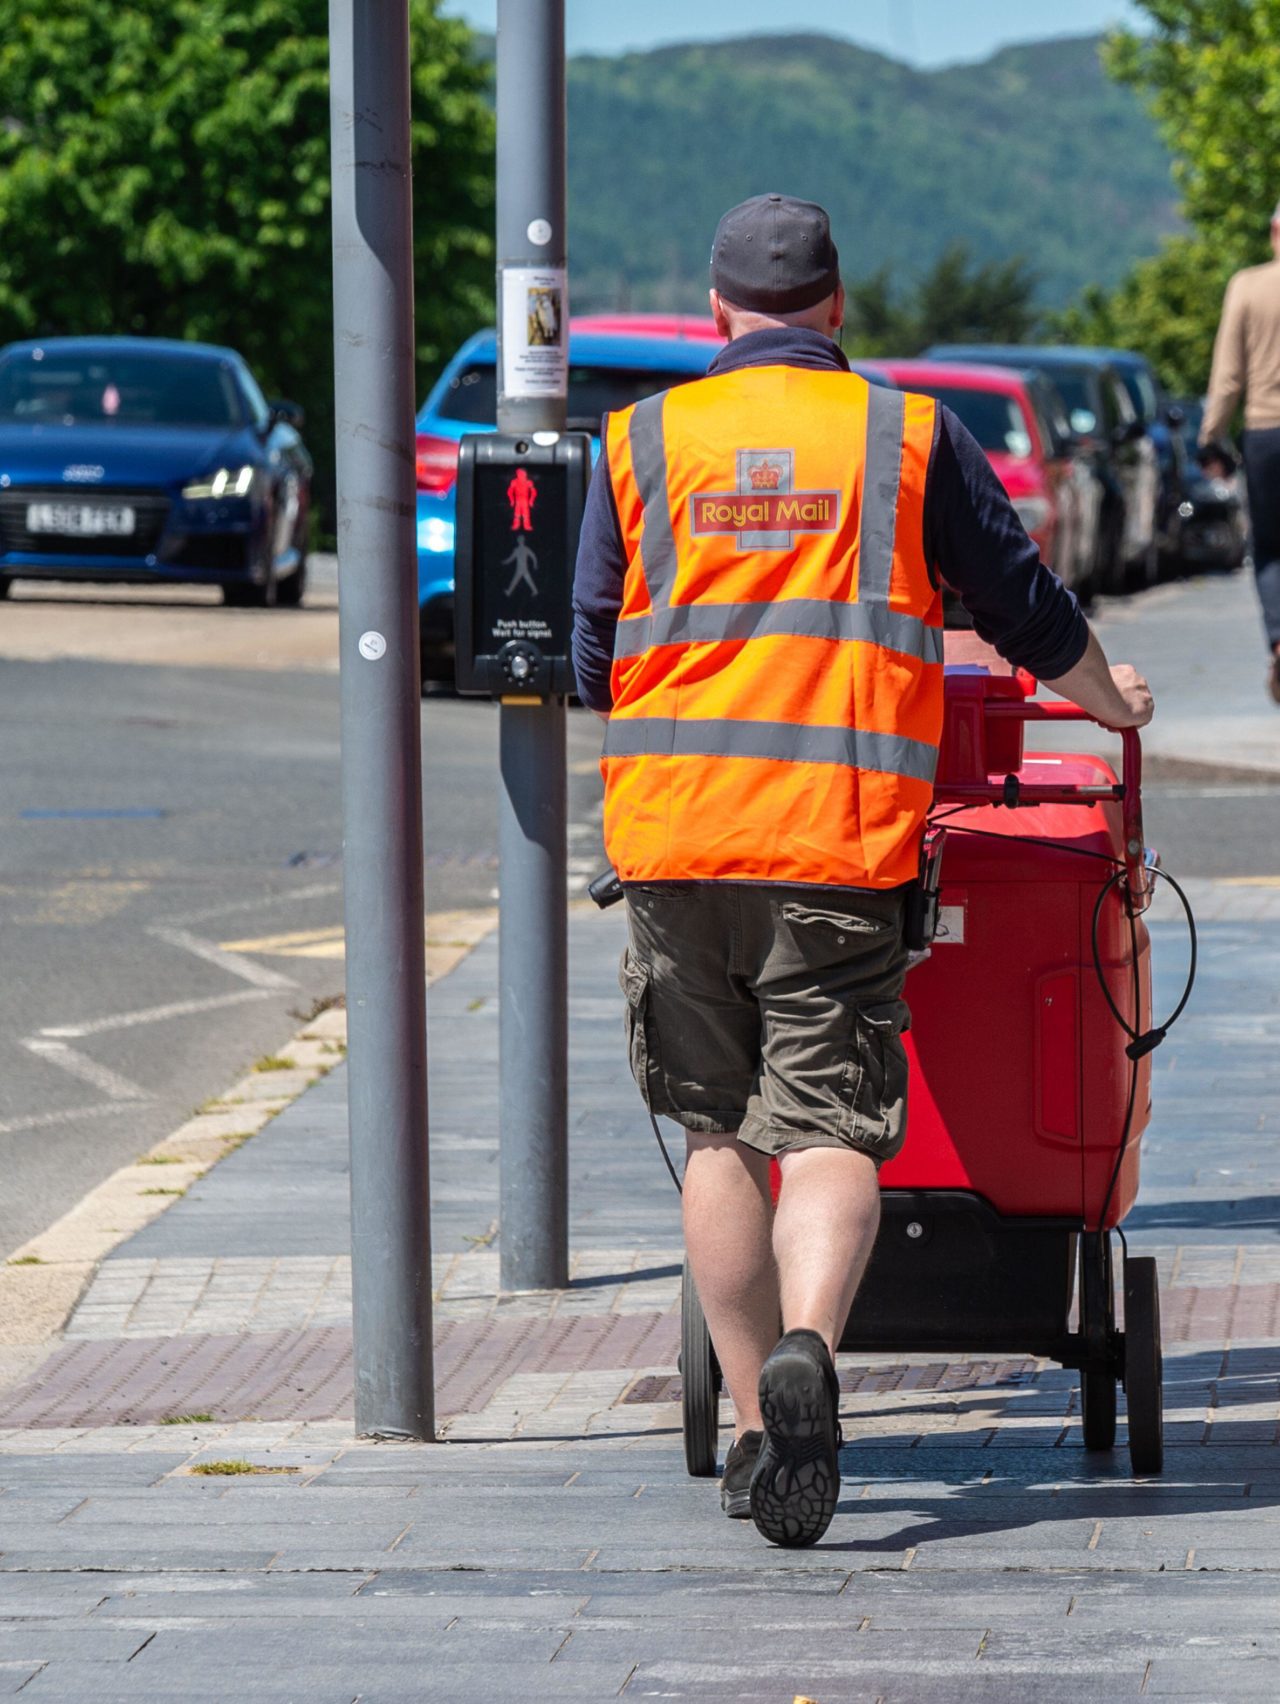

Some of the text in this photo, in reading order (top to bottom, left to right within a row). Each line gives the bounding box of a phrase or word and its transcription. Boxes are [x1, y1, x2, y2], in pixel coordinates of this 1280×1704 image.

[702, 499, 830, 527] Royal Mail
[497, 619, 547, 629] Push button
[492, 628, 511, 637] Wait
[513, 628, 525, 637] for
